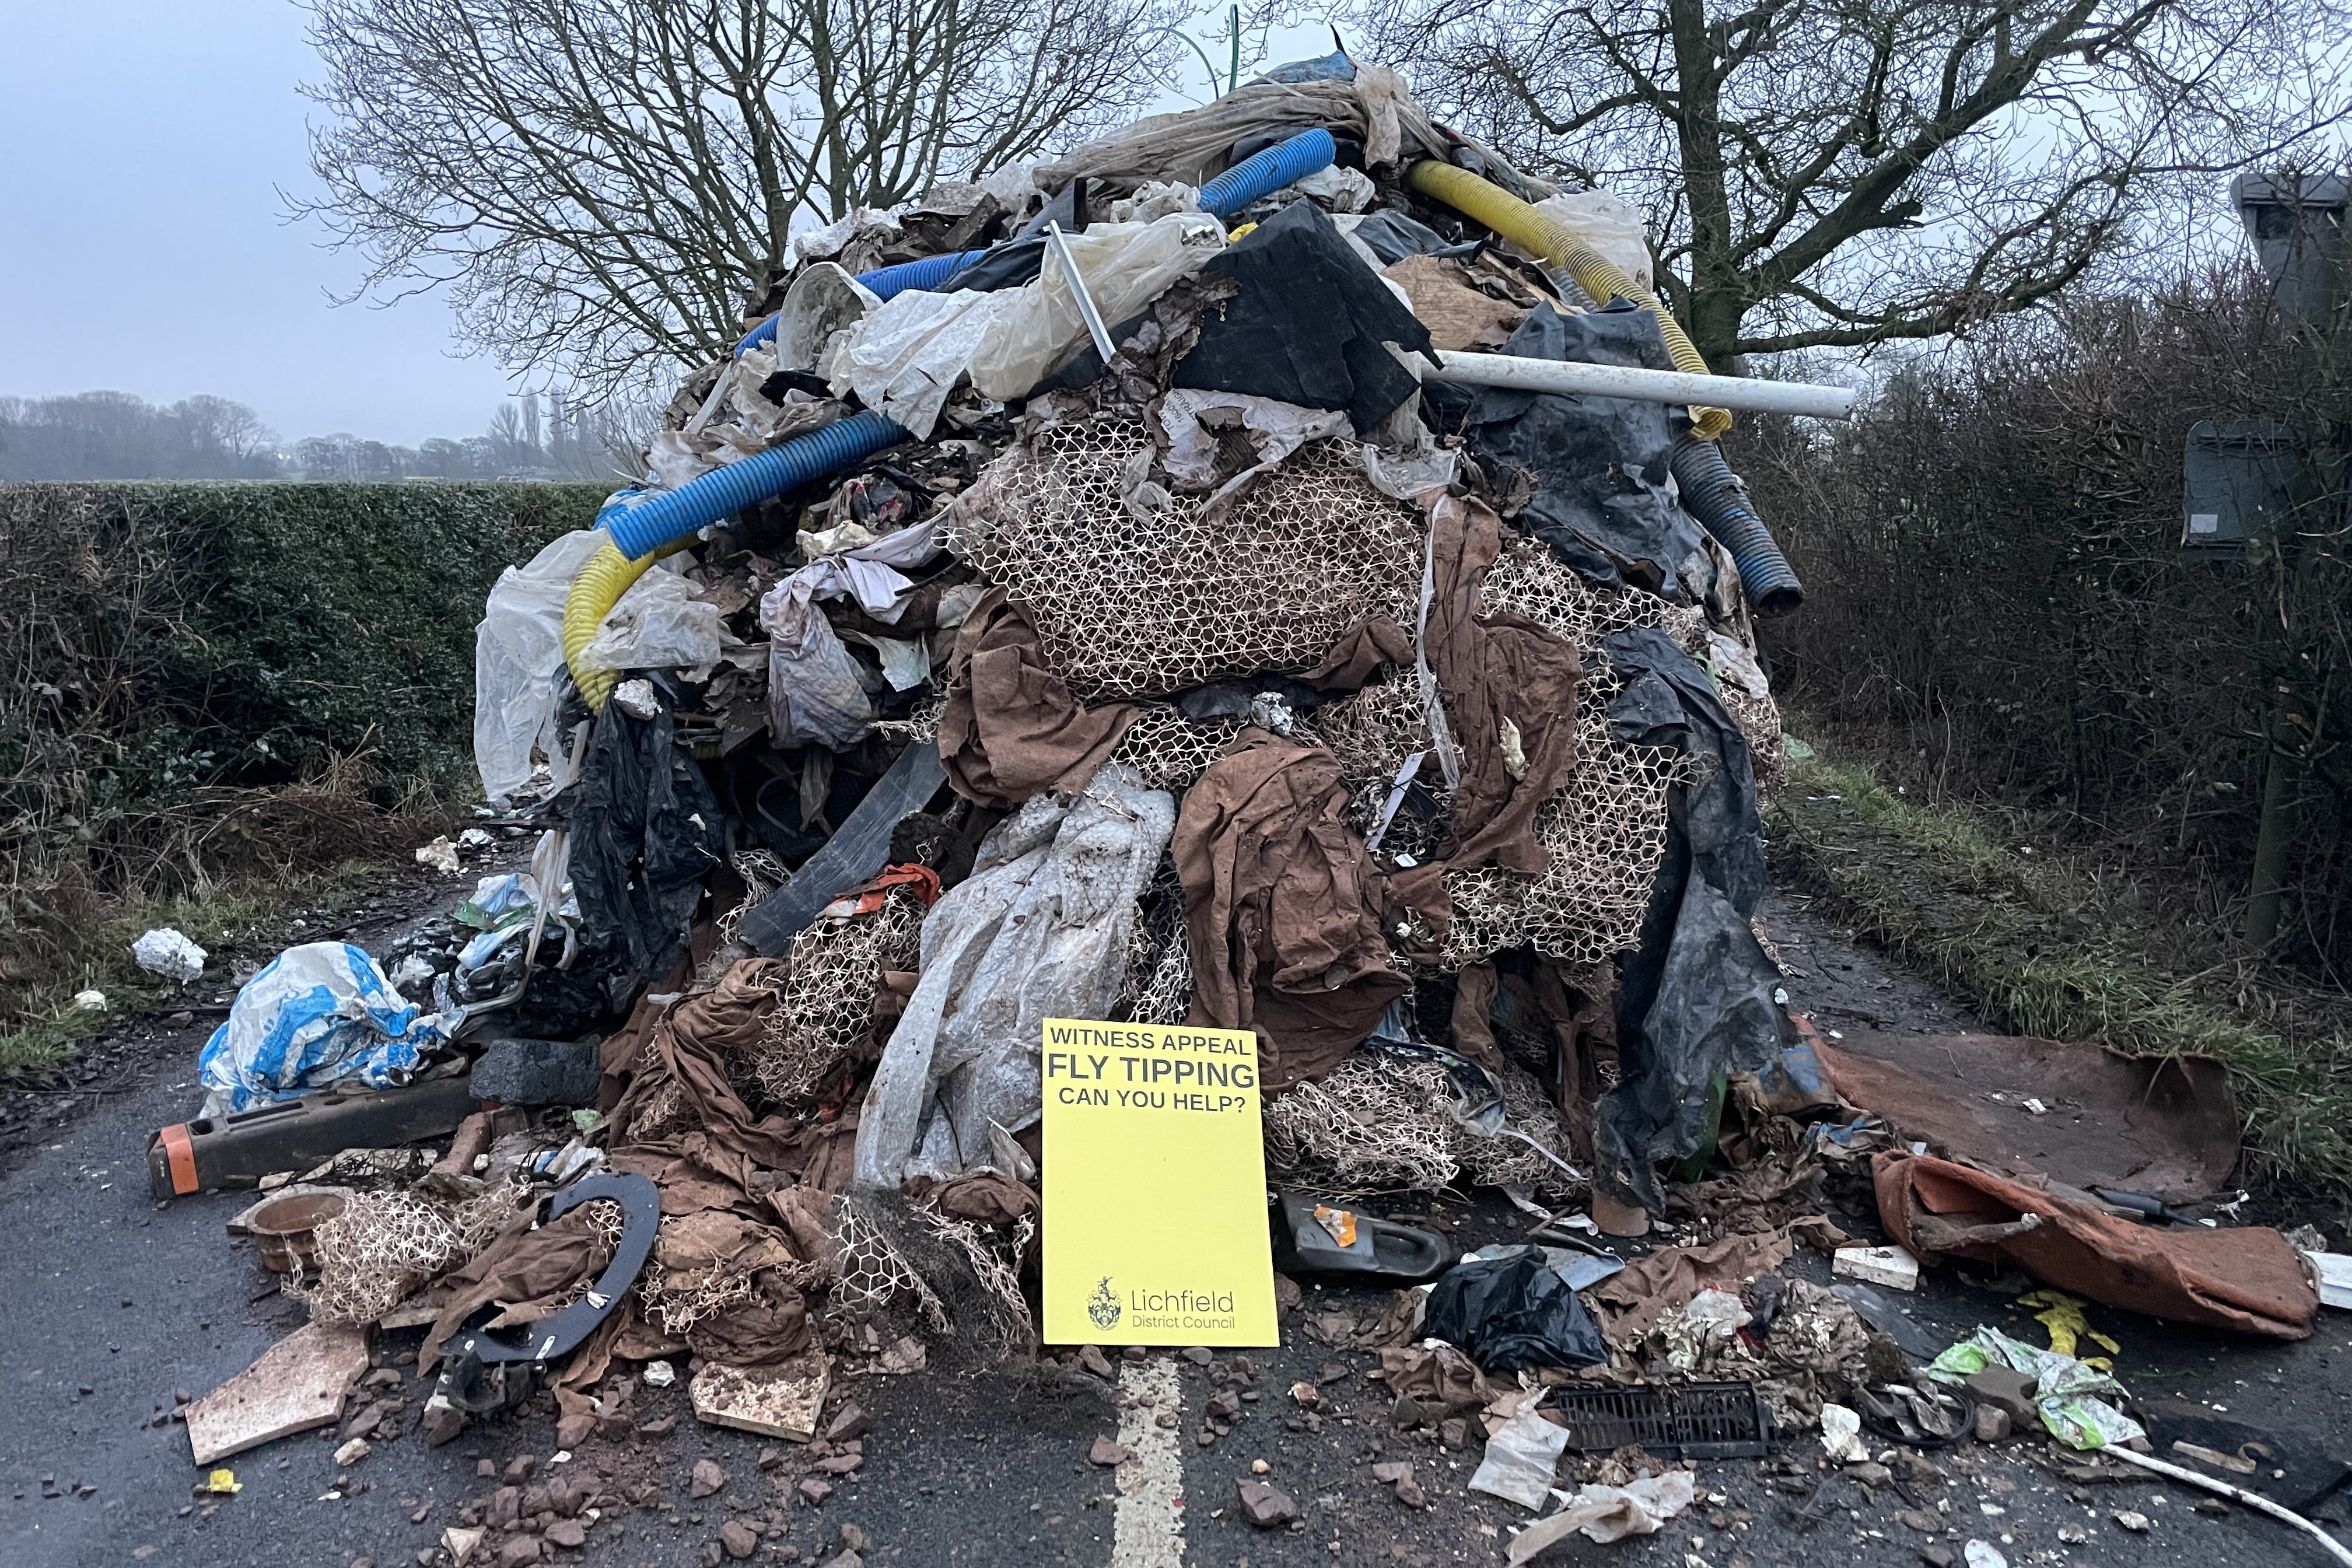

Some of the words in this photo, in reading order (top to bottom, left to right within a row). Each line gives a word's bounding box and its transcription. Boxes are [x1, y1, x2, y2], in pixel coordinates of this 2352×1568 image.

[1051, 1028, 1154, 1049] WITNESS
[1162, 1035, 1251, 1055] APPEAL
[1049, 1054, 1109, 1079] FLY
[1119, 1057, 1254, 1088] TIPPING
[1059, 1088, 1108, 1105] CAN
[1117, 1090, 1164, 1108] YOU
[1174, 1093, 1245, 1112] HELP?
[1132, 1289, 1233, 1312] Lichfield
[1133, 1315, 1179, 1328] District
[1183, 1317, 1234, 1328] Council
